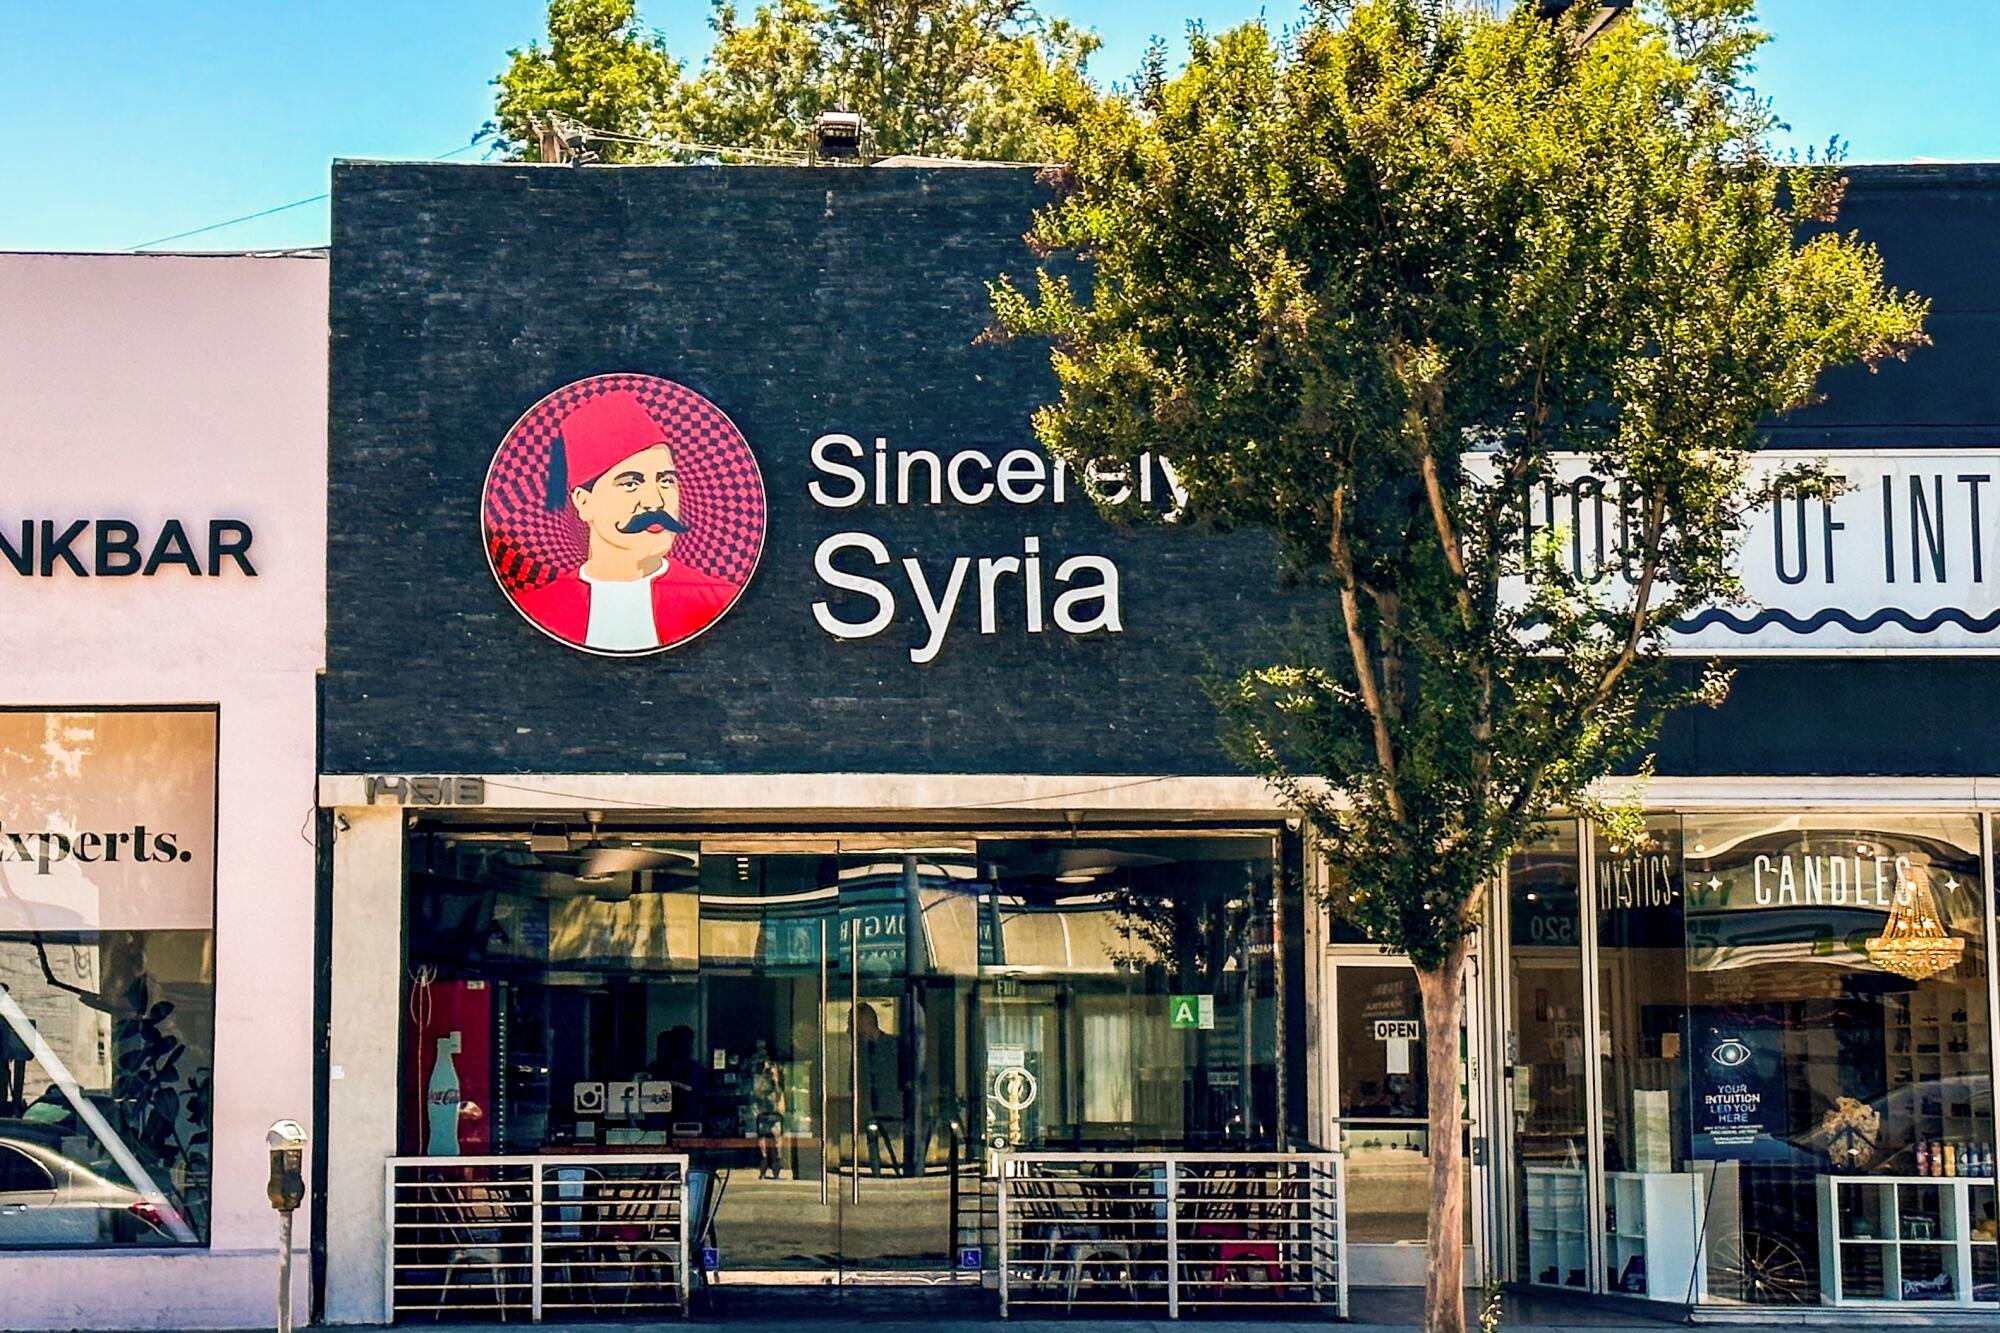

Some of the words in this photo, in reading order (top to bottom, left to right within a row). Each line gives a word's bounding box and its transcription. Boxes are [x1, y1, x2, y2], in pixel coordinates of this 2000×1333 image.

[1523, 475, 1740, 584] HOU
[1774, 475, 1846, 584] OF
[1882, 474, 1990, 584] INT
[0, 519, 258, 577] NKBAR
[812, 531, 1124, 664] Syria
[0, 821, 192, 875] xperts.
[1600, 855, 1672, 911] MYSTICS
[1754, 854, 1913, 906] CANDLES
[1175, 1002, 1194, 1022] A
[1377, 1022, 1417, 1038] OPEN
[1705, 1094, 1760, 1104] INTUITION
[1717, 1084, 1748, 1094] YOUR
[1718, 1113, 1749, 1123] HERE
[1734, 1103, 1756, 1113] YOU
